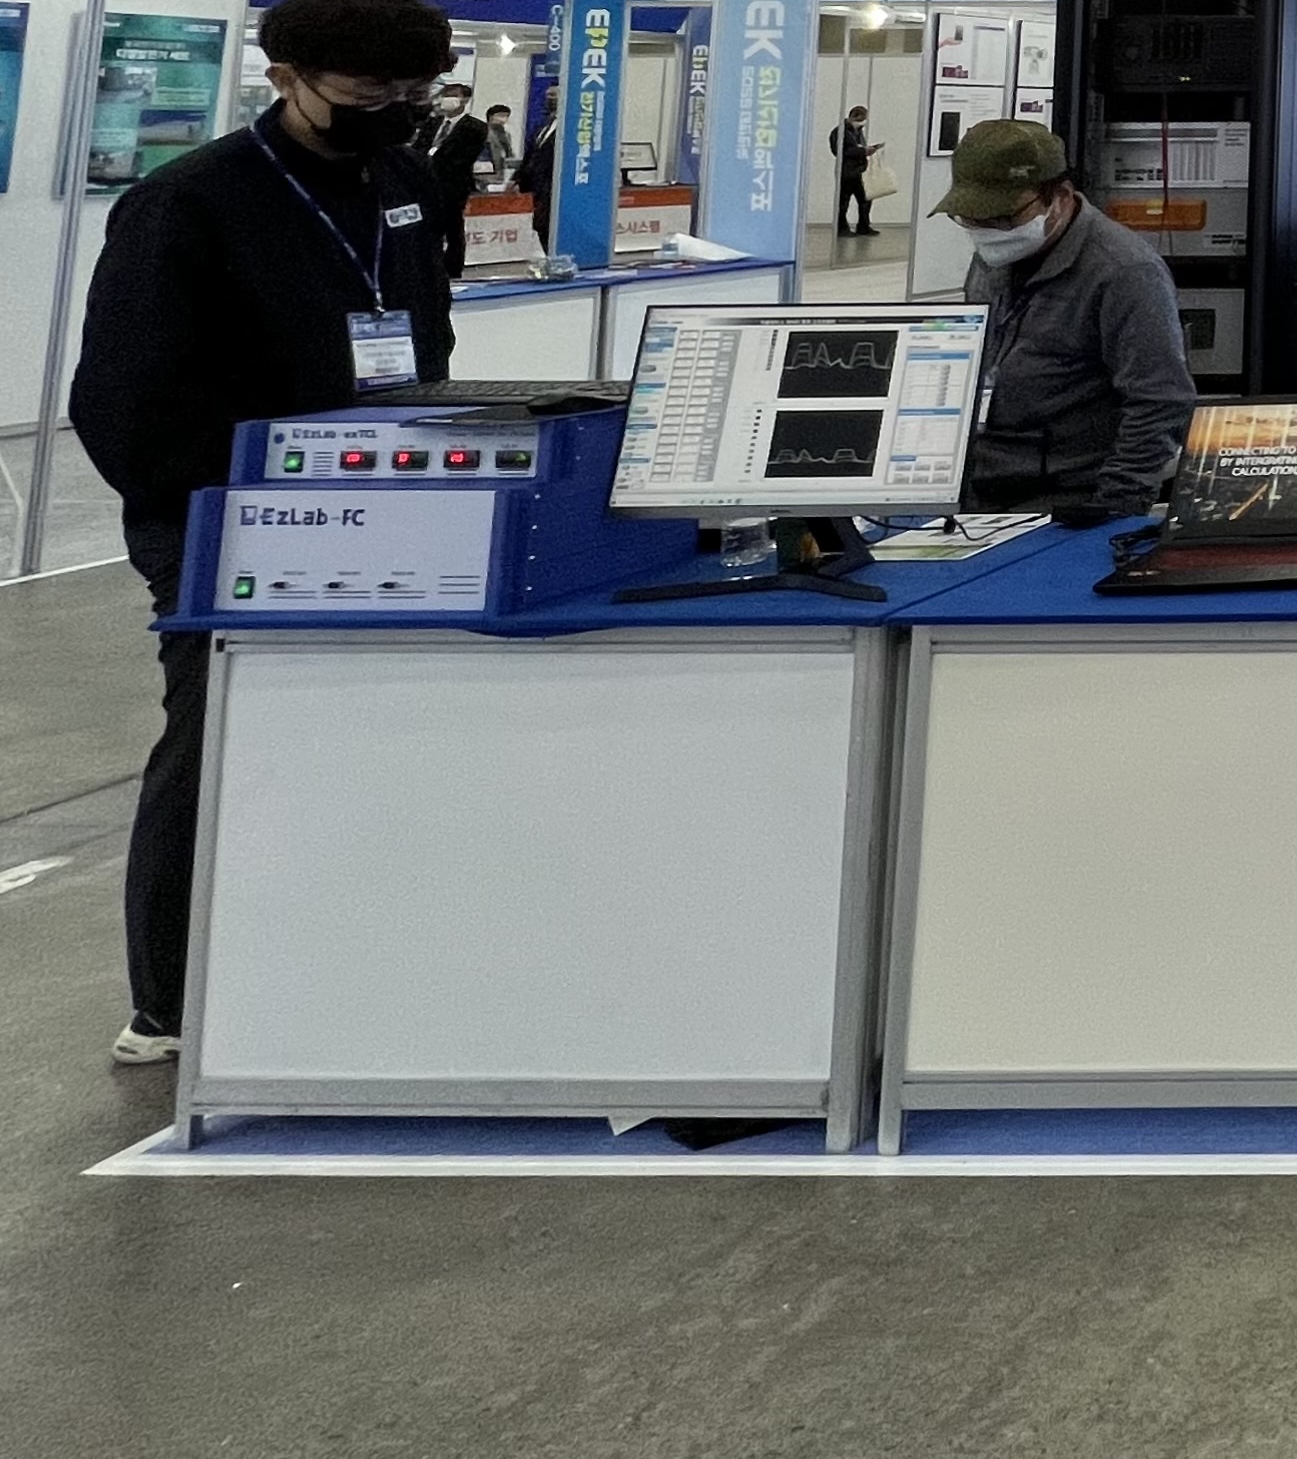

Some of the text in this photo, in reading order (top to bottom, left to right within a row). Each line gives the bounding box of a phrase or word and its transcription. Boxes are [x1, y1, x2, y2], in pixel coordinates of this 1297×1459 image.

[549, 4, 563, 51] C-400
[581, 8, 612, 89] EPEK
[489, 229, 518, 243] 기업
[1218, 445, 1282, 457] CONNECTING
[1282, 445, 1297, 455] TO
[1220, 457, 1233, 467] BY
[260, 507, 366, 527] EzLab-FC
